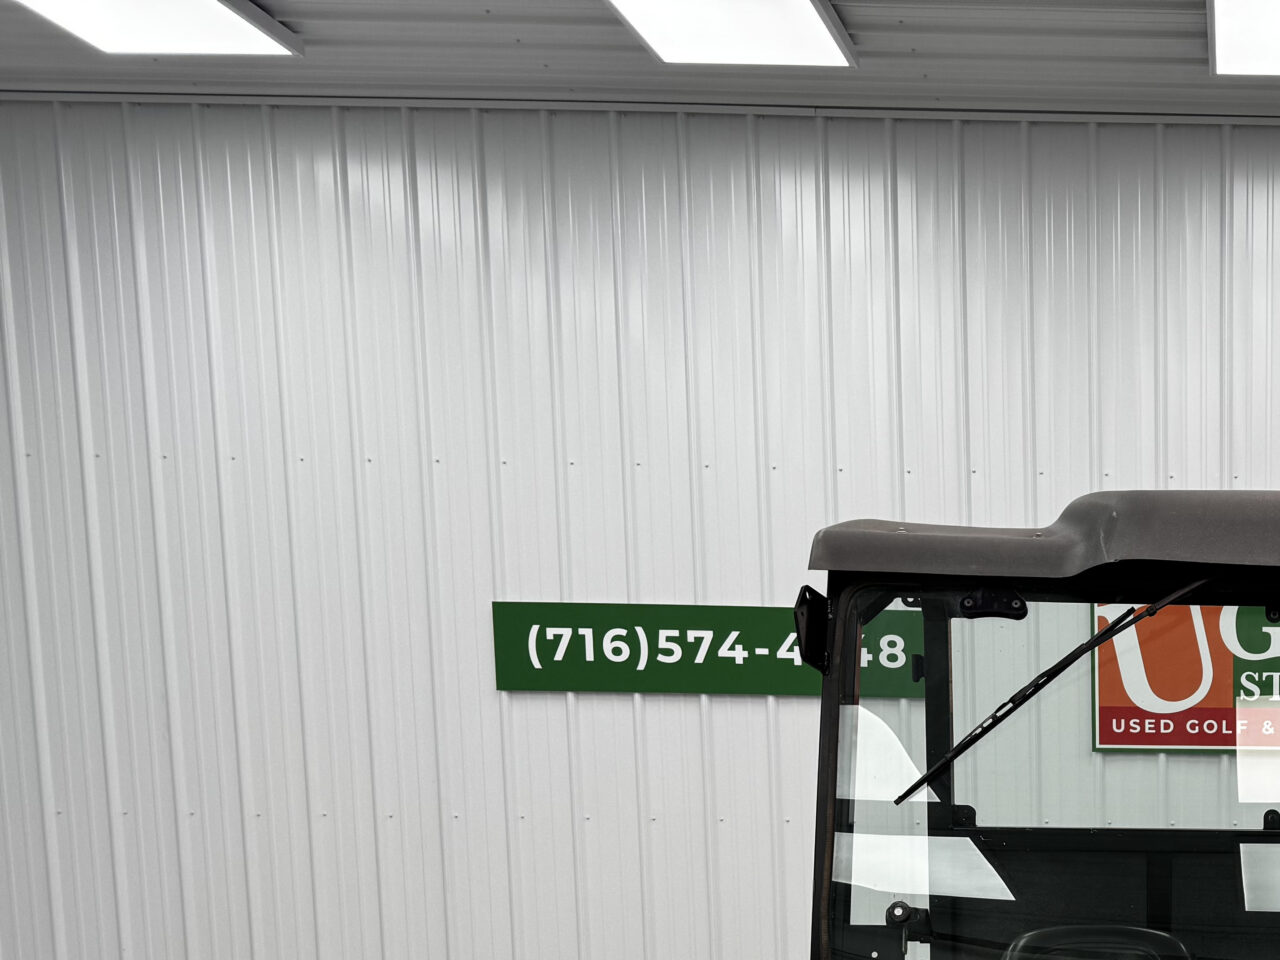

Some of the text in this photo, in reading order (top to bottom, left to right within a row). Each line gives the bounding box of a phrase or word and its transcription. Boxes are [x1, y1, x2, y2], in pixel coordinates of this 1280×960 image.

[527, 624, 907, 670] (716)574-48
[1112, 718, 1175, 734] USED
[1185, 719, 1249, 735] GOLF
[1261, 720, 1275, 735] &
